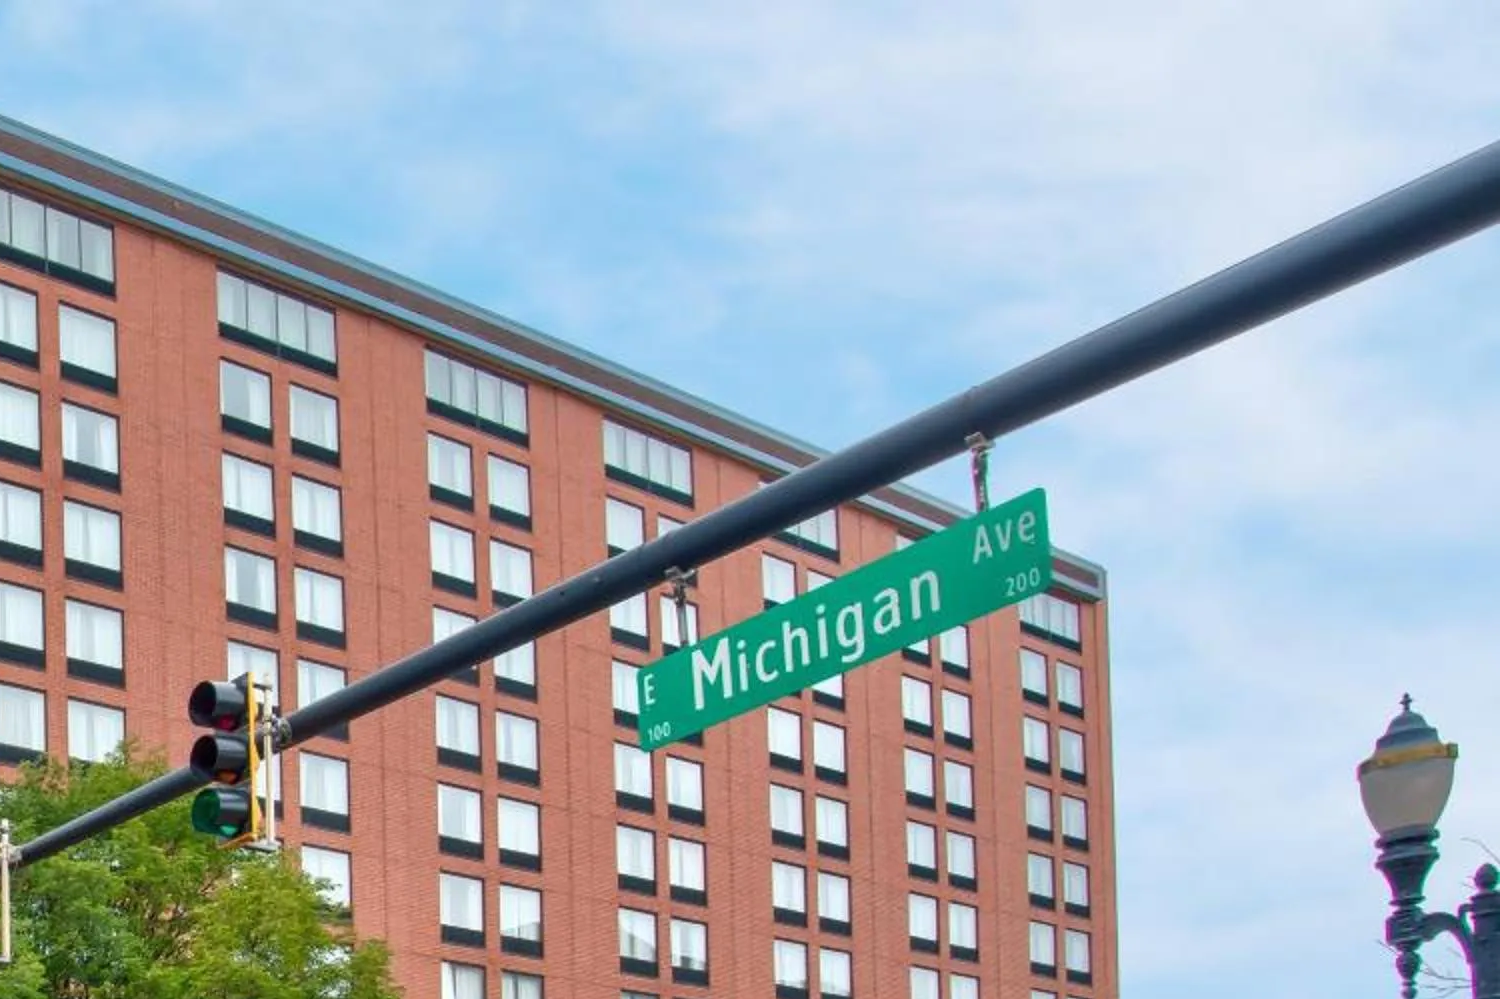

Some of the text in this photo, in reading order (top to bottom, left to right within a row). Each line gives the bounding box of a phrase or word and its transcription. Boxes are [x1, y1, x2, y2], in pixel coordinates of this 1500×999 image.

[1004, 567, 1041, 597] 200
[643, 511, 1036, 710] E Michigan Ave
[648, 721, 671, 742] 100
